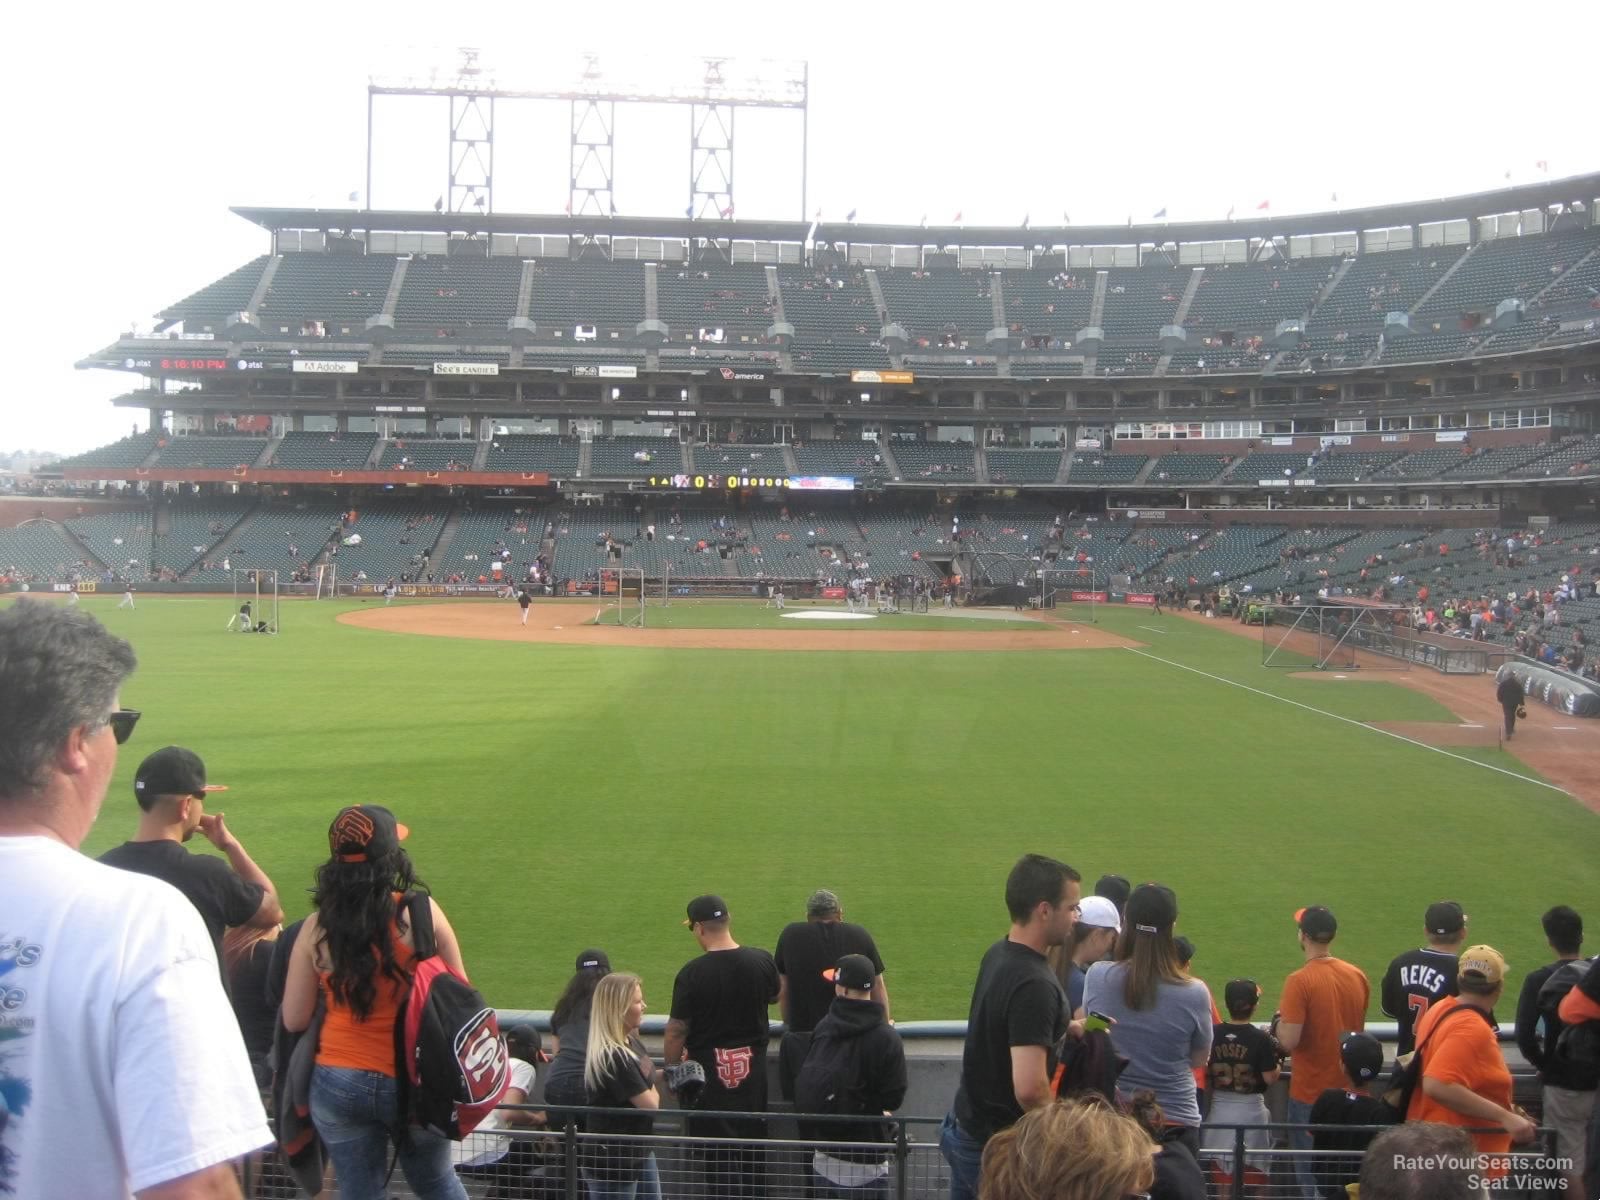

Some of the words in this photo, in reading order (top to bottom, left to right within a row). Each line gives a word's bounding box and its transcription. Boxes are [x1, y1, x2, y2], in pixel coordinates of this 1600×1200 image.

[207, 360, 226, 369] PM
[317, 362, 346, 372] Adobe
[1400, 964, 1445, 993] REYES
